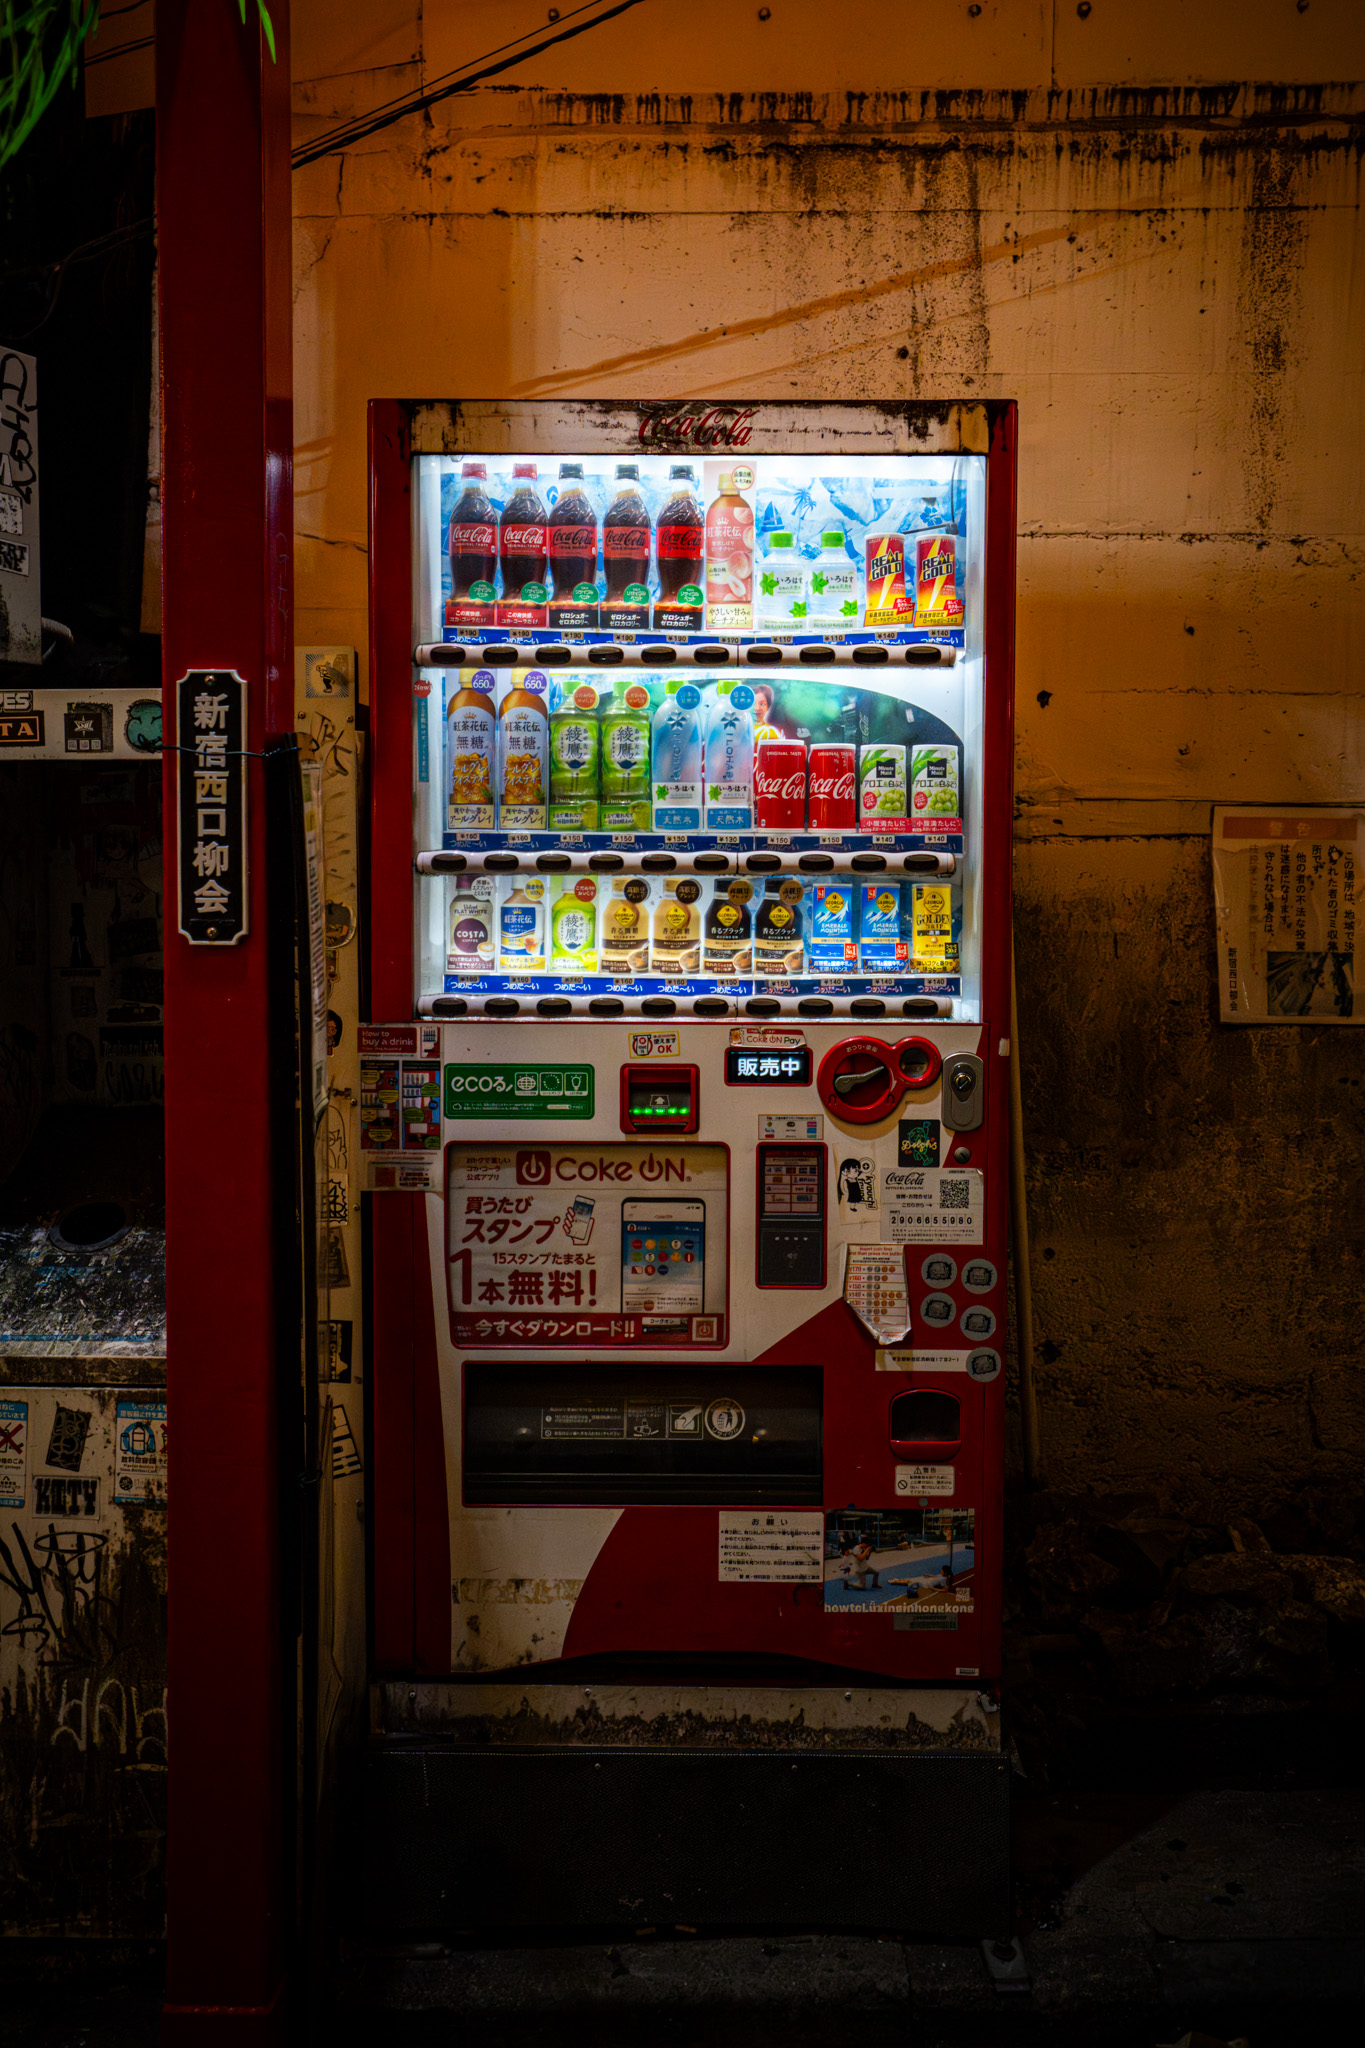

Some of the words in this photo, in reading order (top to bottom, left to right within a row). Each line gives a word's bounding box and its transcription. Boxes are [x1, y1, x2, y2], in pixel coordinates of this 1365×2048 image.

[638, 408, 759, 446] Coca-Cola
[453, 526, 493, 543] Coca-Cola
[504, 527, 544, 544] Coca-Cola
[552, 529, 594, 546] Coca-Cola
[661, 530, 702, 547] Coca-Cola
[871, 549, 899, 568] REAL
[922, 550, 950, 568] REAL
[872, 561, 901, 580] GOLD
[923, 562, 952, 582] GOLD
[0, 692, 31, 710] ES
[0, 722, 35, 736] TA
[453, 721, 489, 732] 紅茶花伝
[505, 721, 541, 732] 紅茶花伝
[193, 693, 231, 914] 新宿西口柳会
[450, 814, 492, 824] アールグレイ
[501, 815, 543, 824] アールグレイ
[716, 815, 744, 825] 天然水
[1269, 822, 1311, 837] 警告
[1264, 852, 1275, 937] 守られない場合は、
[1344, 852, 1355, 952] この場所は、地域で決
[504, 915, 533, 923] 紅茶花伝
[916, 914, 950, 925] GOLDEN
[456, 930, 485, 938] COSTA
[565, 915, 579, 942] 綾鷹
[362, 1038, 380, 1047] buy
[747, 1035, 768, 1043] Coke
[784, 1037, 800, 1045] Pay
[658, 1045, 672, 1053] OK
[737, 1057, 800, 1077] 販売中
[555, 1156, 632, 1182] Coke
[639, 1153, 685, 1182] ON
[466, 1173, 500, 1181] 公式アプリ
[885, 1172, 926, 1186] Coca-Cola
[464, 1196, 534, 1214] 買うたび
[461, 1216, 561, 1244] スタンプ
[492, 1252, 596, 1265] 15スタンプたまると
[449, 1248, 598, 1306] 1本無料!
[474, 1319, 635, 1338] 今すぐダウンロード!!
